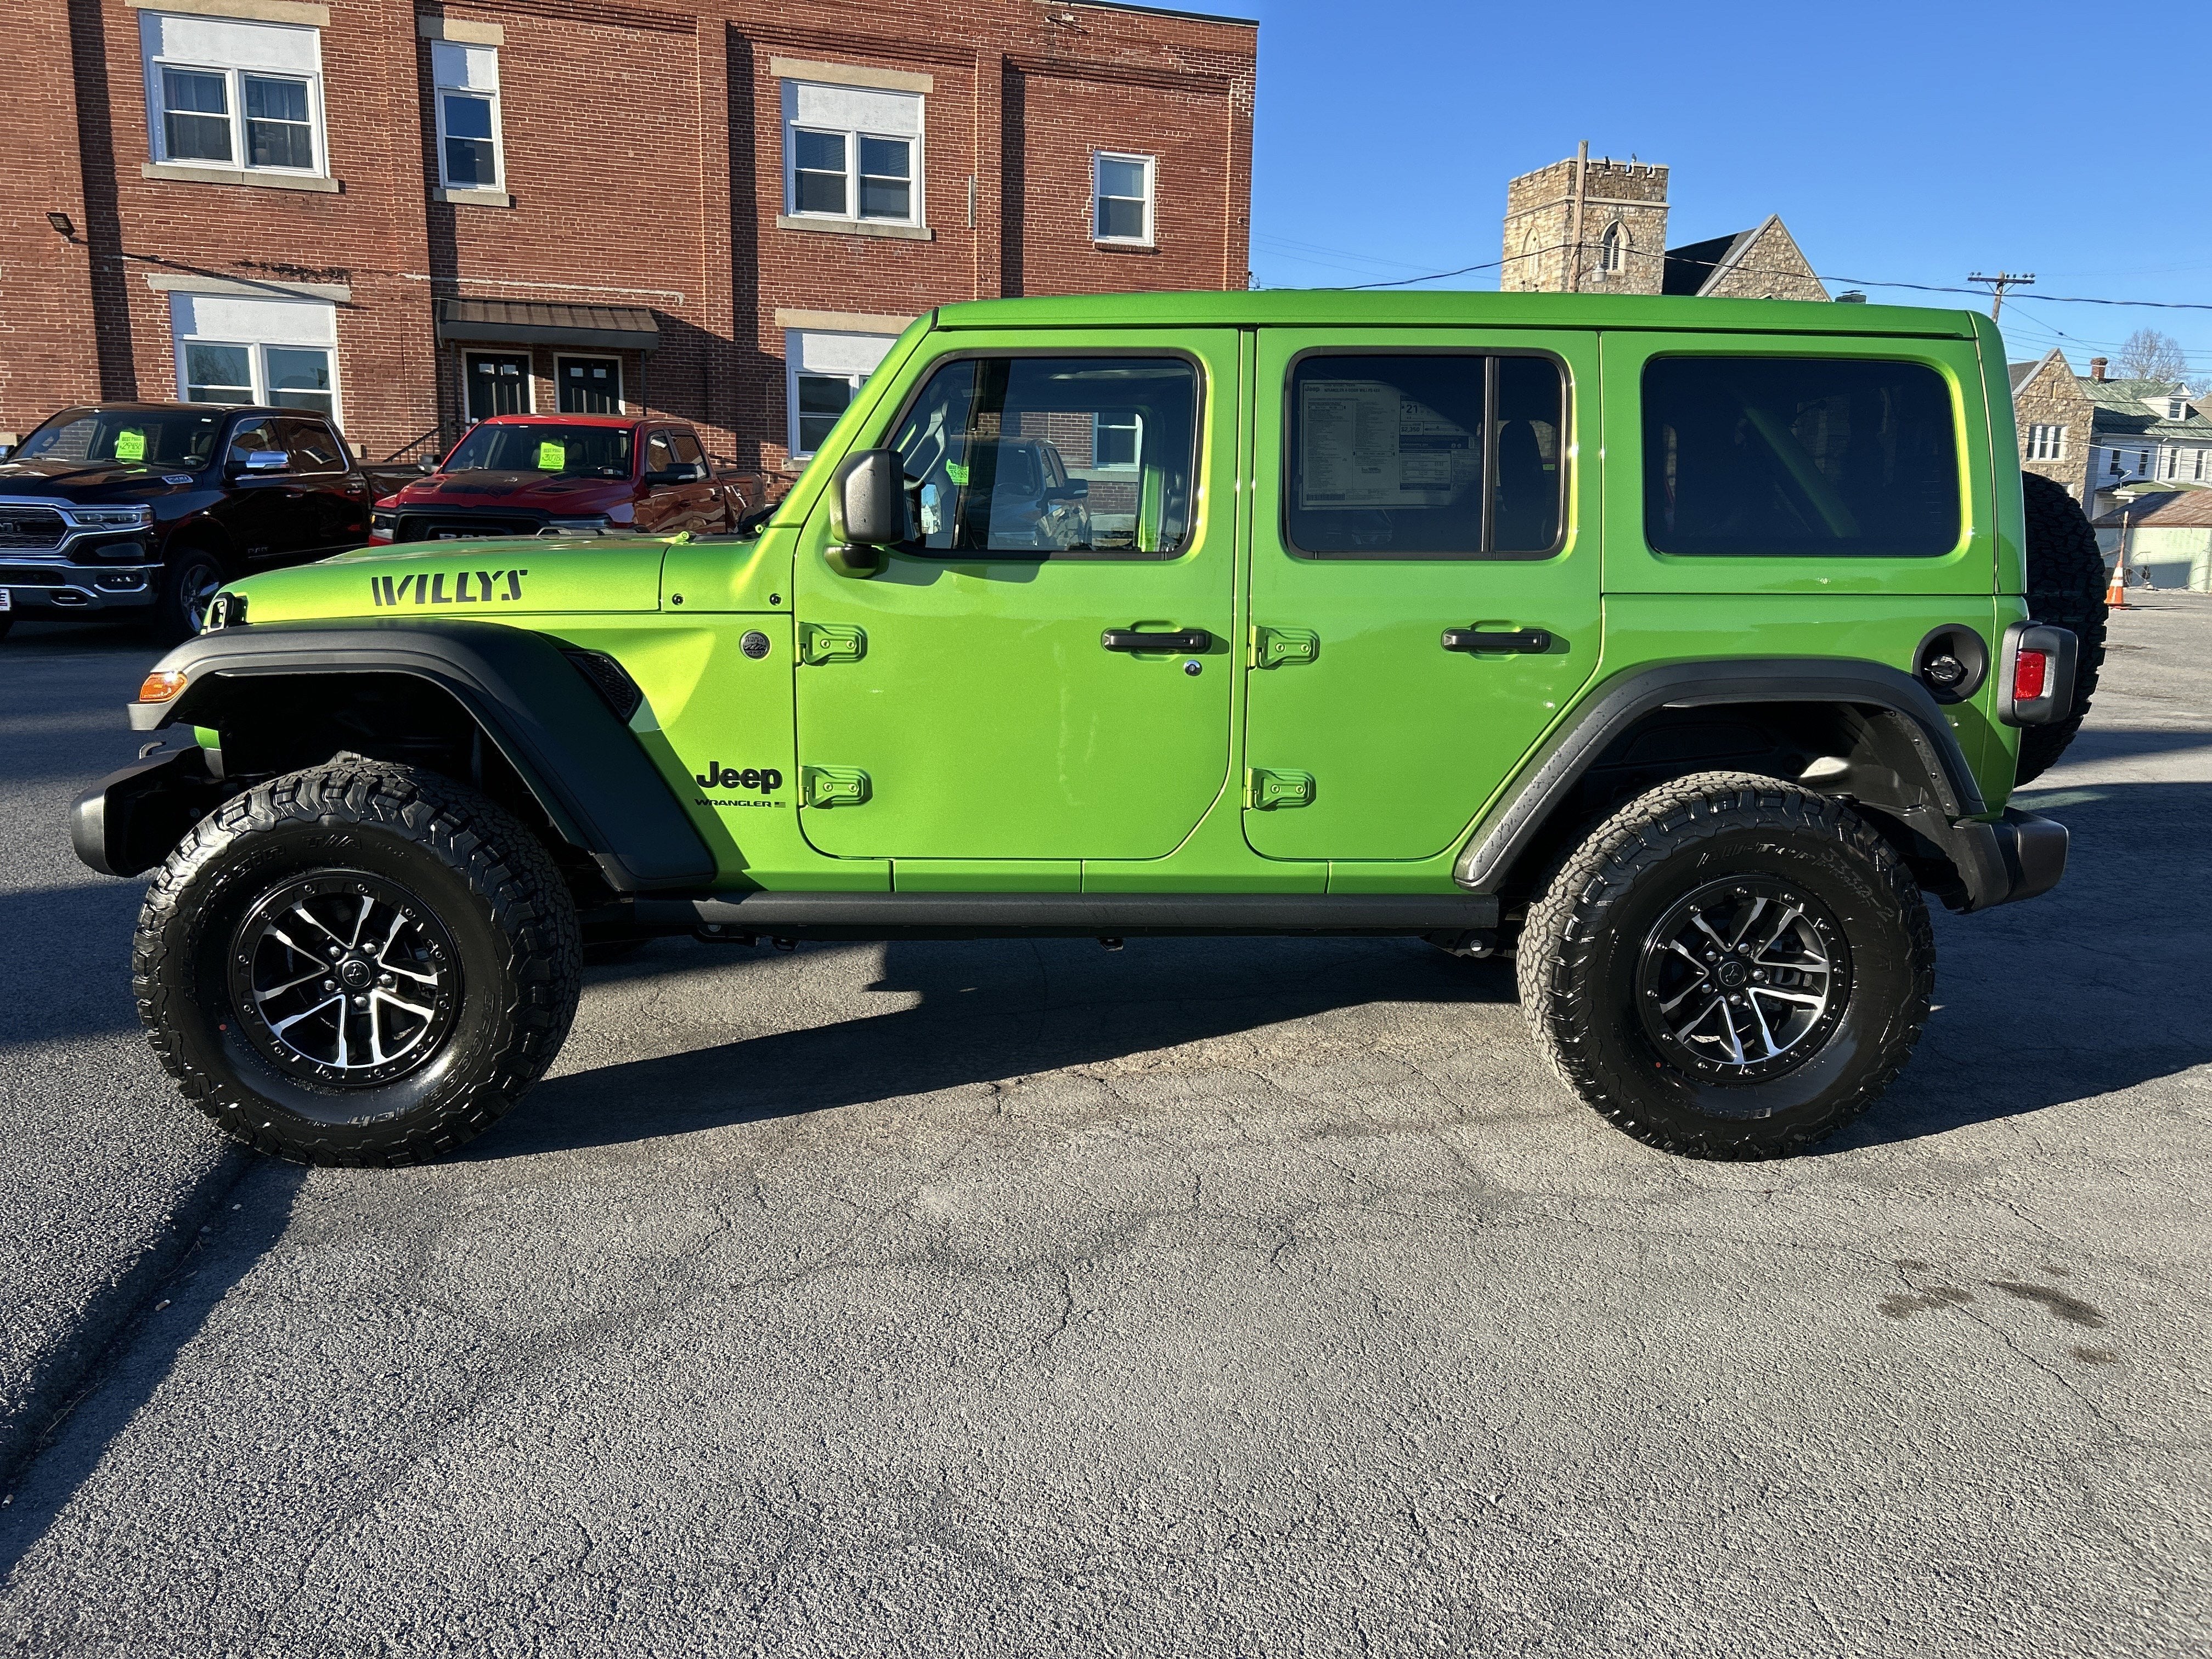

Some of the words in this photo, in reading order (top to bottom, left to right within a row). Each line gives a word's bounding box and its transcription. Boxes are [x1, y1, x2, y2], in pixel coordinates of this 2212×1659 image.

[1406, 404, 1418, 414] 21
[371, 569, 528, 606] WILLYS
[696, 761, 783, 794] Jeep
[695, 799, 772, 808] WRANGLER
